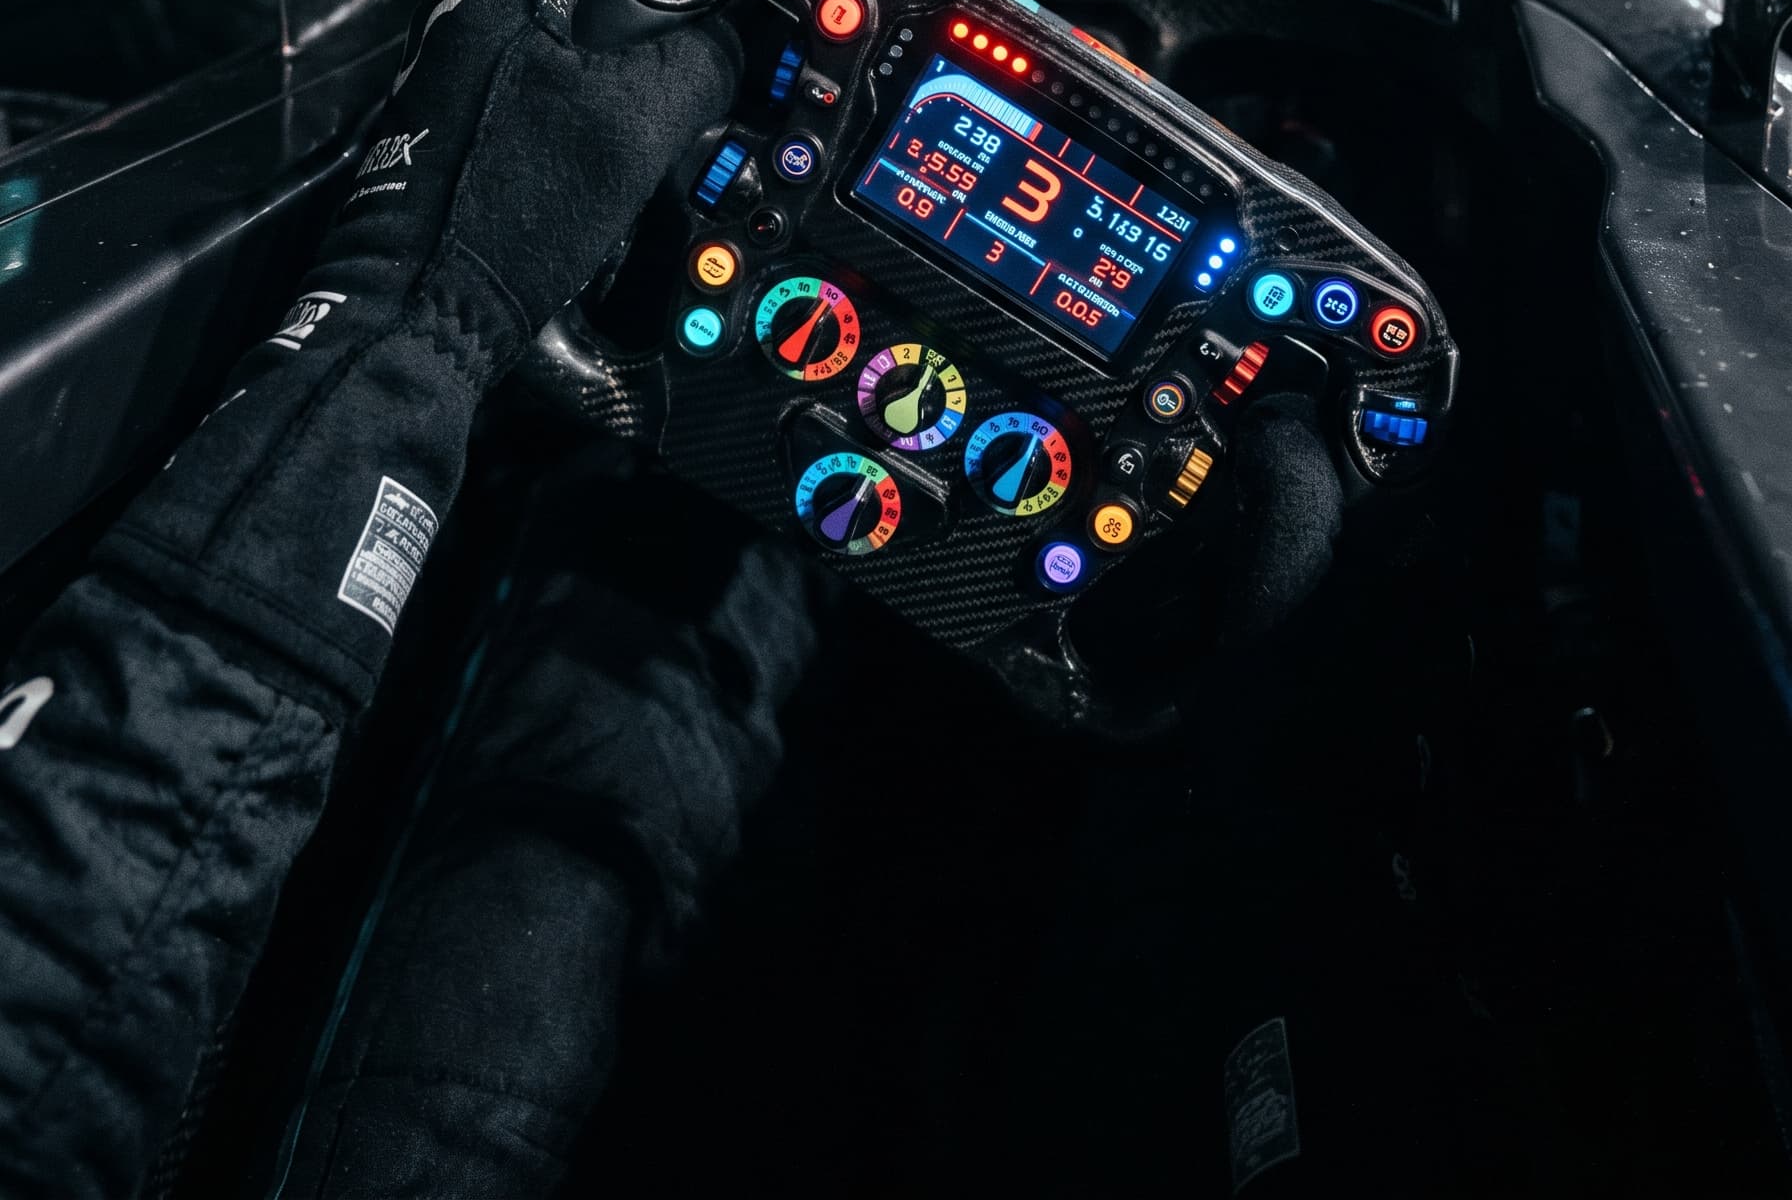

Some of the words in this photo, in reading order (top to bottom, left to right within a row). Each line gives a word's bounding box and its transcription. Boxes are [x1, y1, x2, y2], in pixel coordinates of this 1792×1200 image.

[952, 115, 1002, 154] 238
[1000, 157, 1063, 225] 3
[985, 242, 1006, 265] 3
